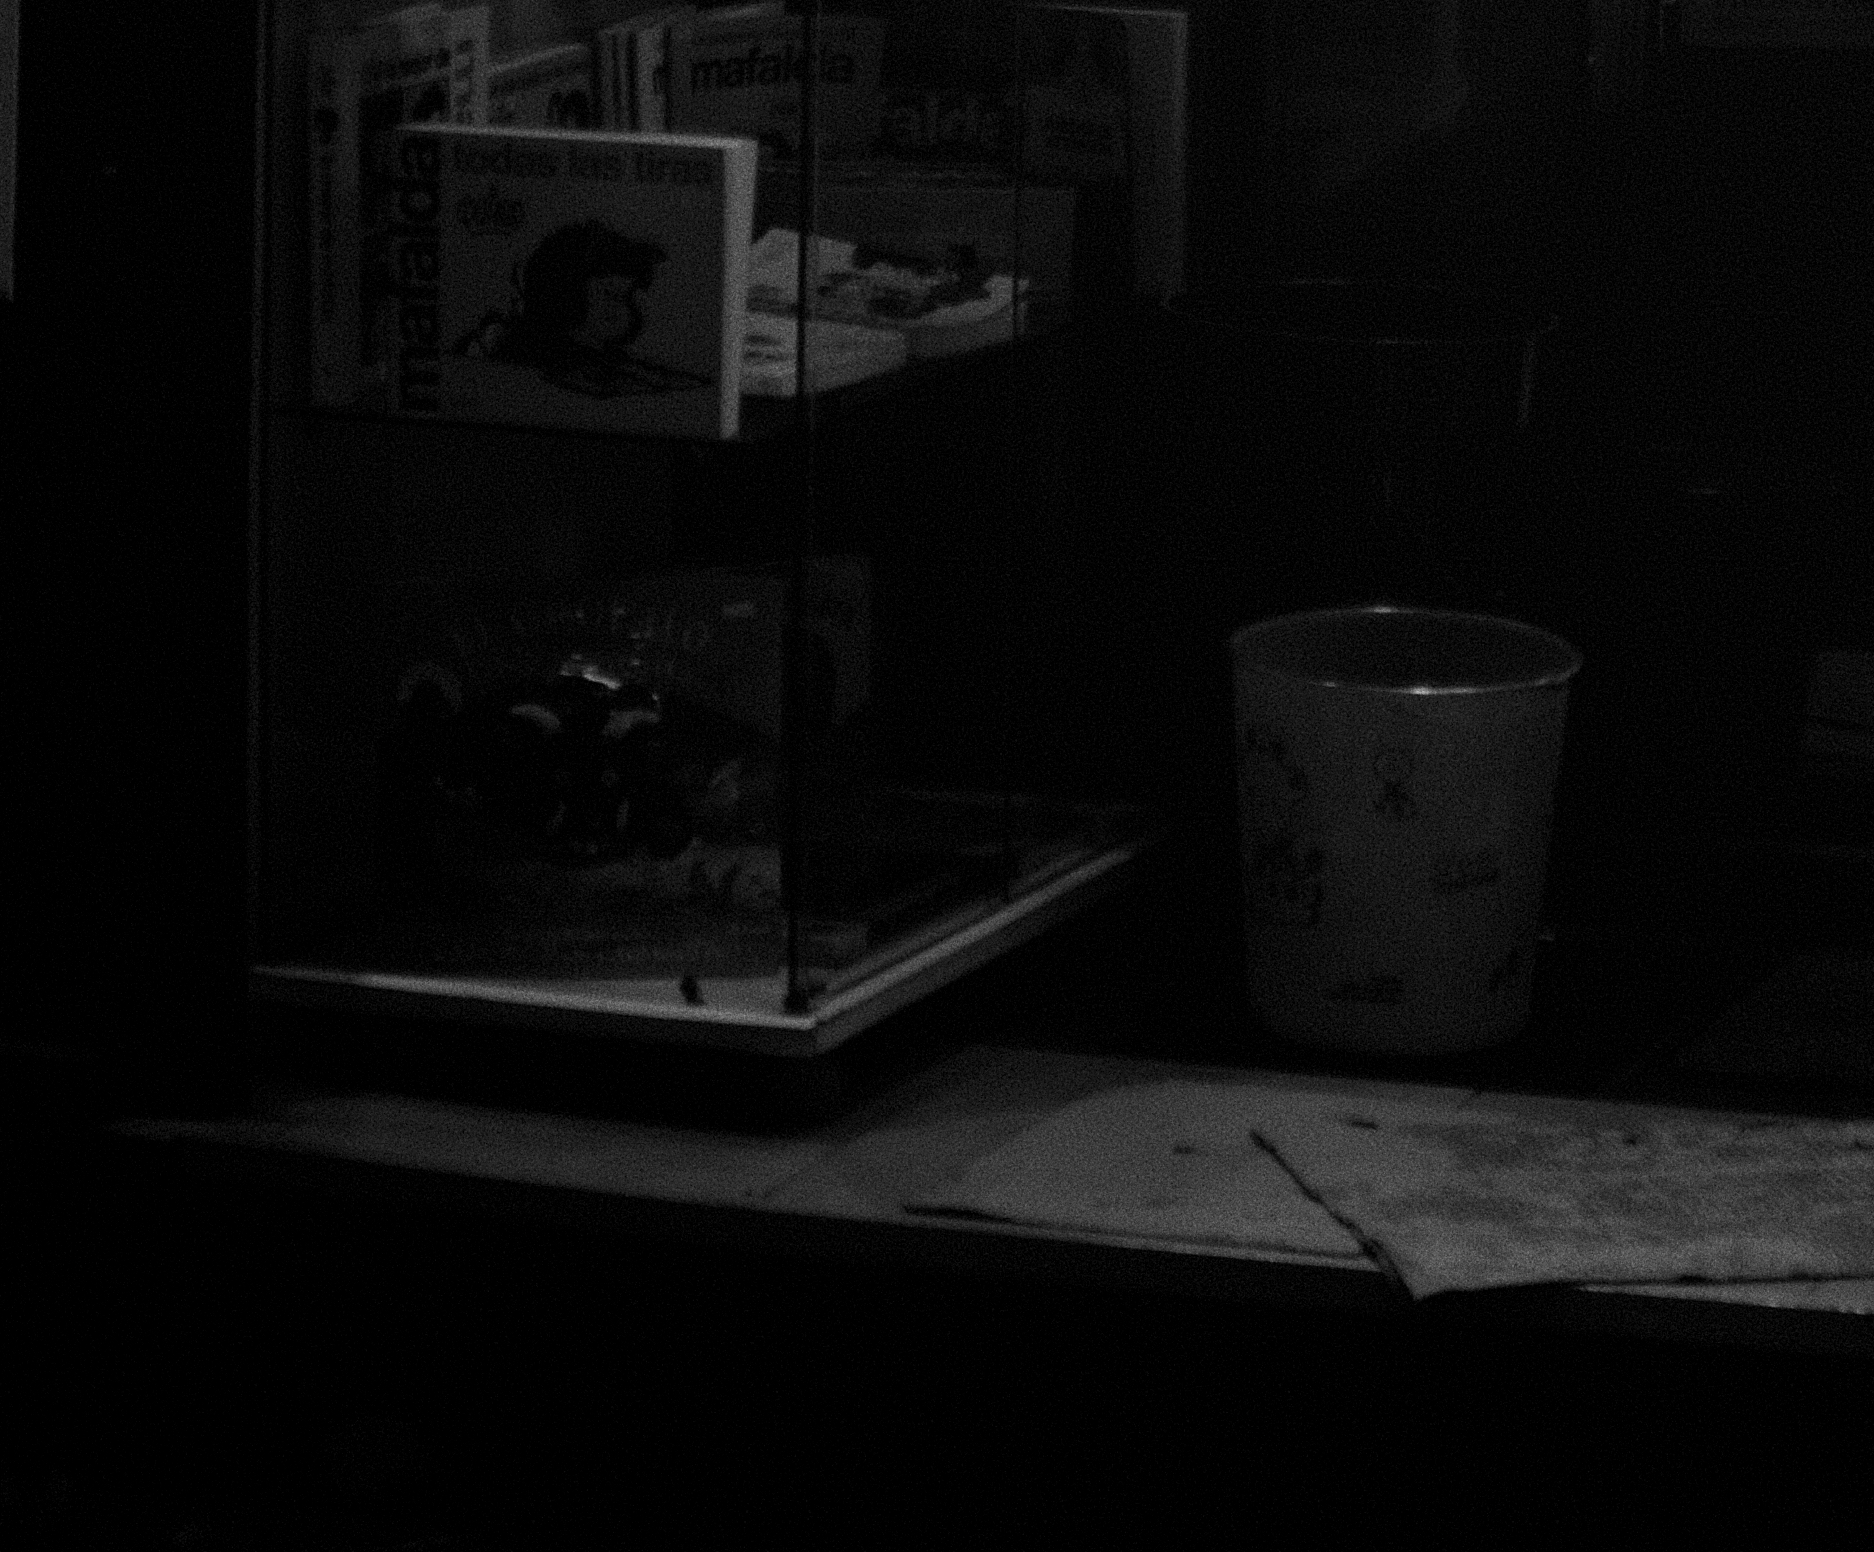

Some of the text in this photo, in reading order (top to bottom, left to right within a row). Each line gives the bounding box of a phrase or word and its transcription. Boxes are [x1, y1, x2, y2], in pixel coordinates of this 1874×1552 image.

[690, 43, 855, 93] mafalda
[882, 93, 1005, 147] alda
[453, 143, 713, 187] todas las tiras
[383, 136, 439, 412] mafalda
